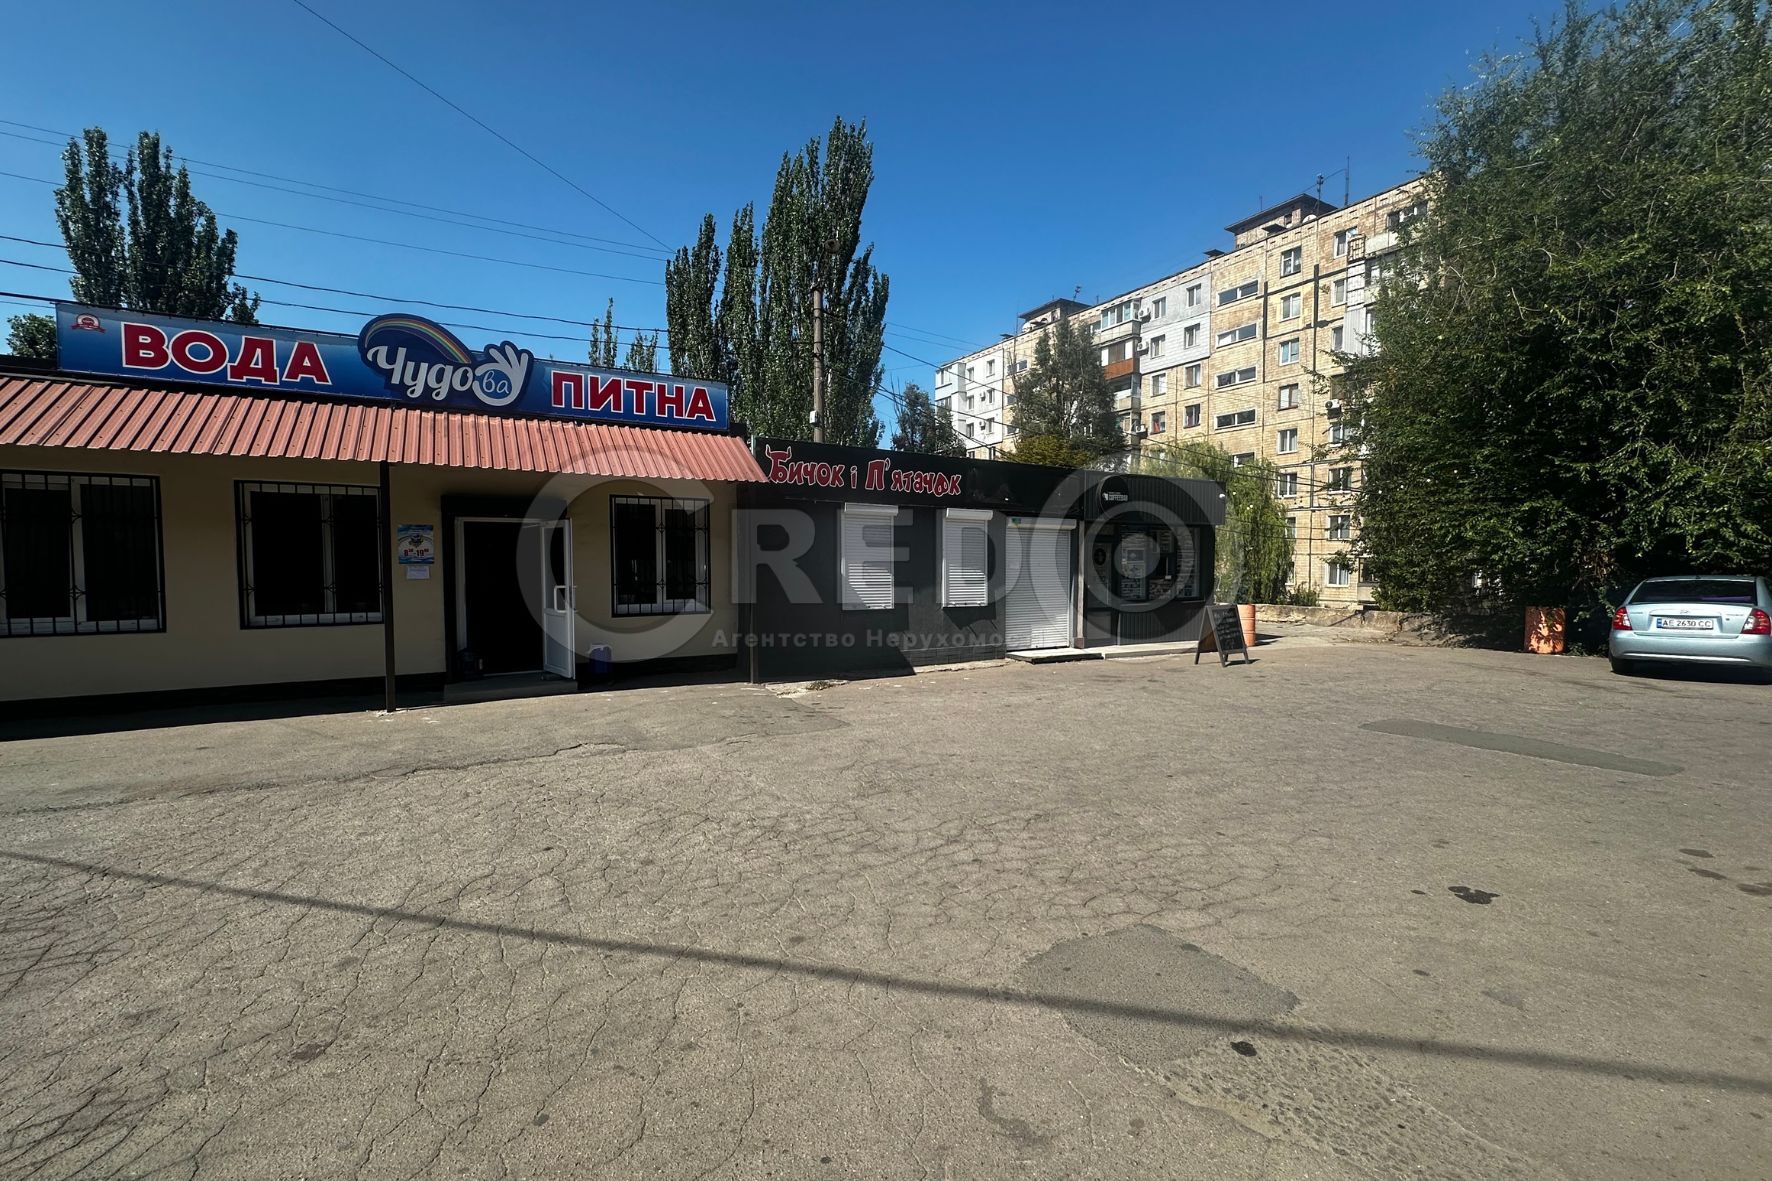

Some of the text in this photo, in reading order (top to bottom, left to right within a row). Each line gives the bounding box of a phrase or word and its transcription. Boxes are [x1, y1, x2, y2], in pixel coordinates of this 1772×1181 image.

[121, 321, 332, 385] ВОДА
[551, 370, 716, 421] ПИТНА
[765, 444, 845, 487] Бичок
[1698, 620, 1711, 628] CC
